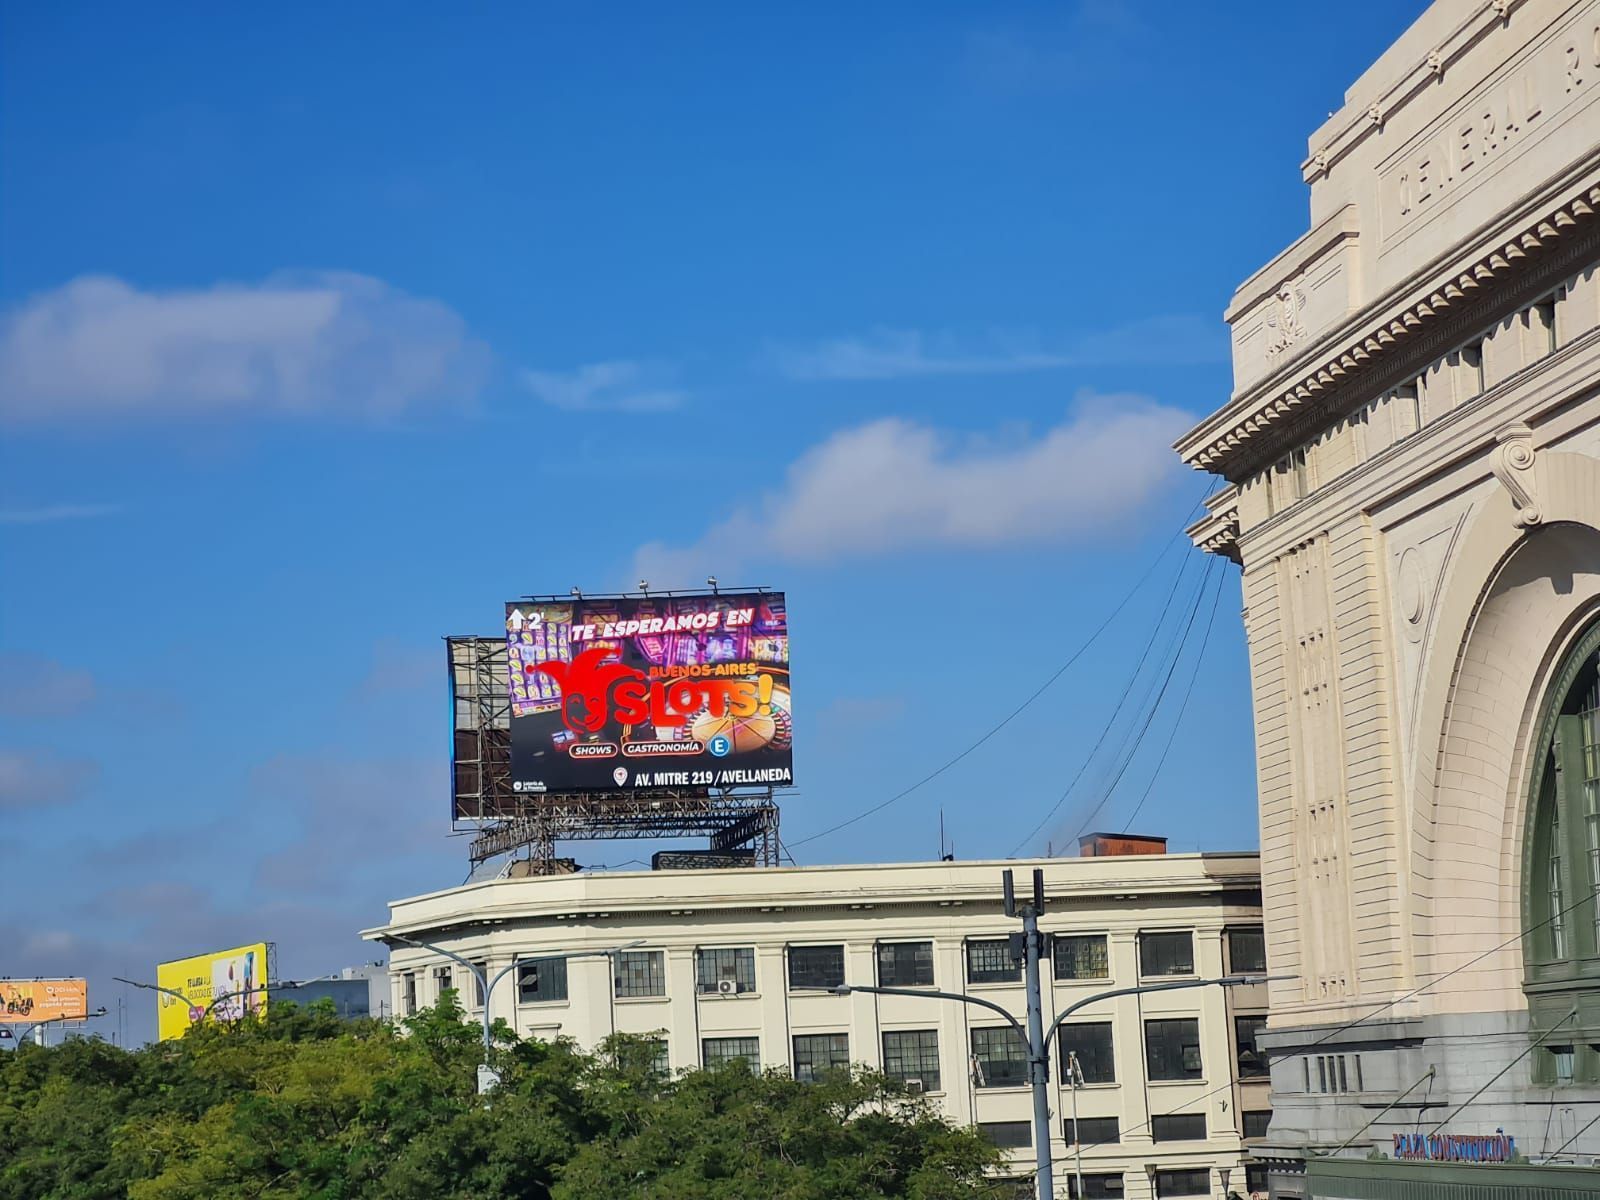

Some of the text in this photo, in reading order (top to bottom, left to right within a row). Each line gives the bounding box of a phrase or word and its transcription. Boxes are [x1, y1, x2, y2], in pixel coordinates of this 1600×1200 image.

[1400, 76, 1543, 215] GENERAL
[572, 608, 753, 641] TE ESPERAMOS EN
[649, 662, 758, 678] BUENOS AIRES
[614, 673, 773, 727] SLOTS!
[575, 745, 612, 755] SHOWS
[627, 741, 699, 753] GASTRONOMÍA
[635, 773, 651, 787] AV.
[654, 771, 689, 786] MITRE
[691, 770, 713, 785] 219
